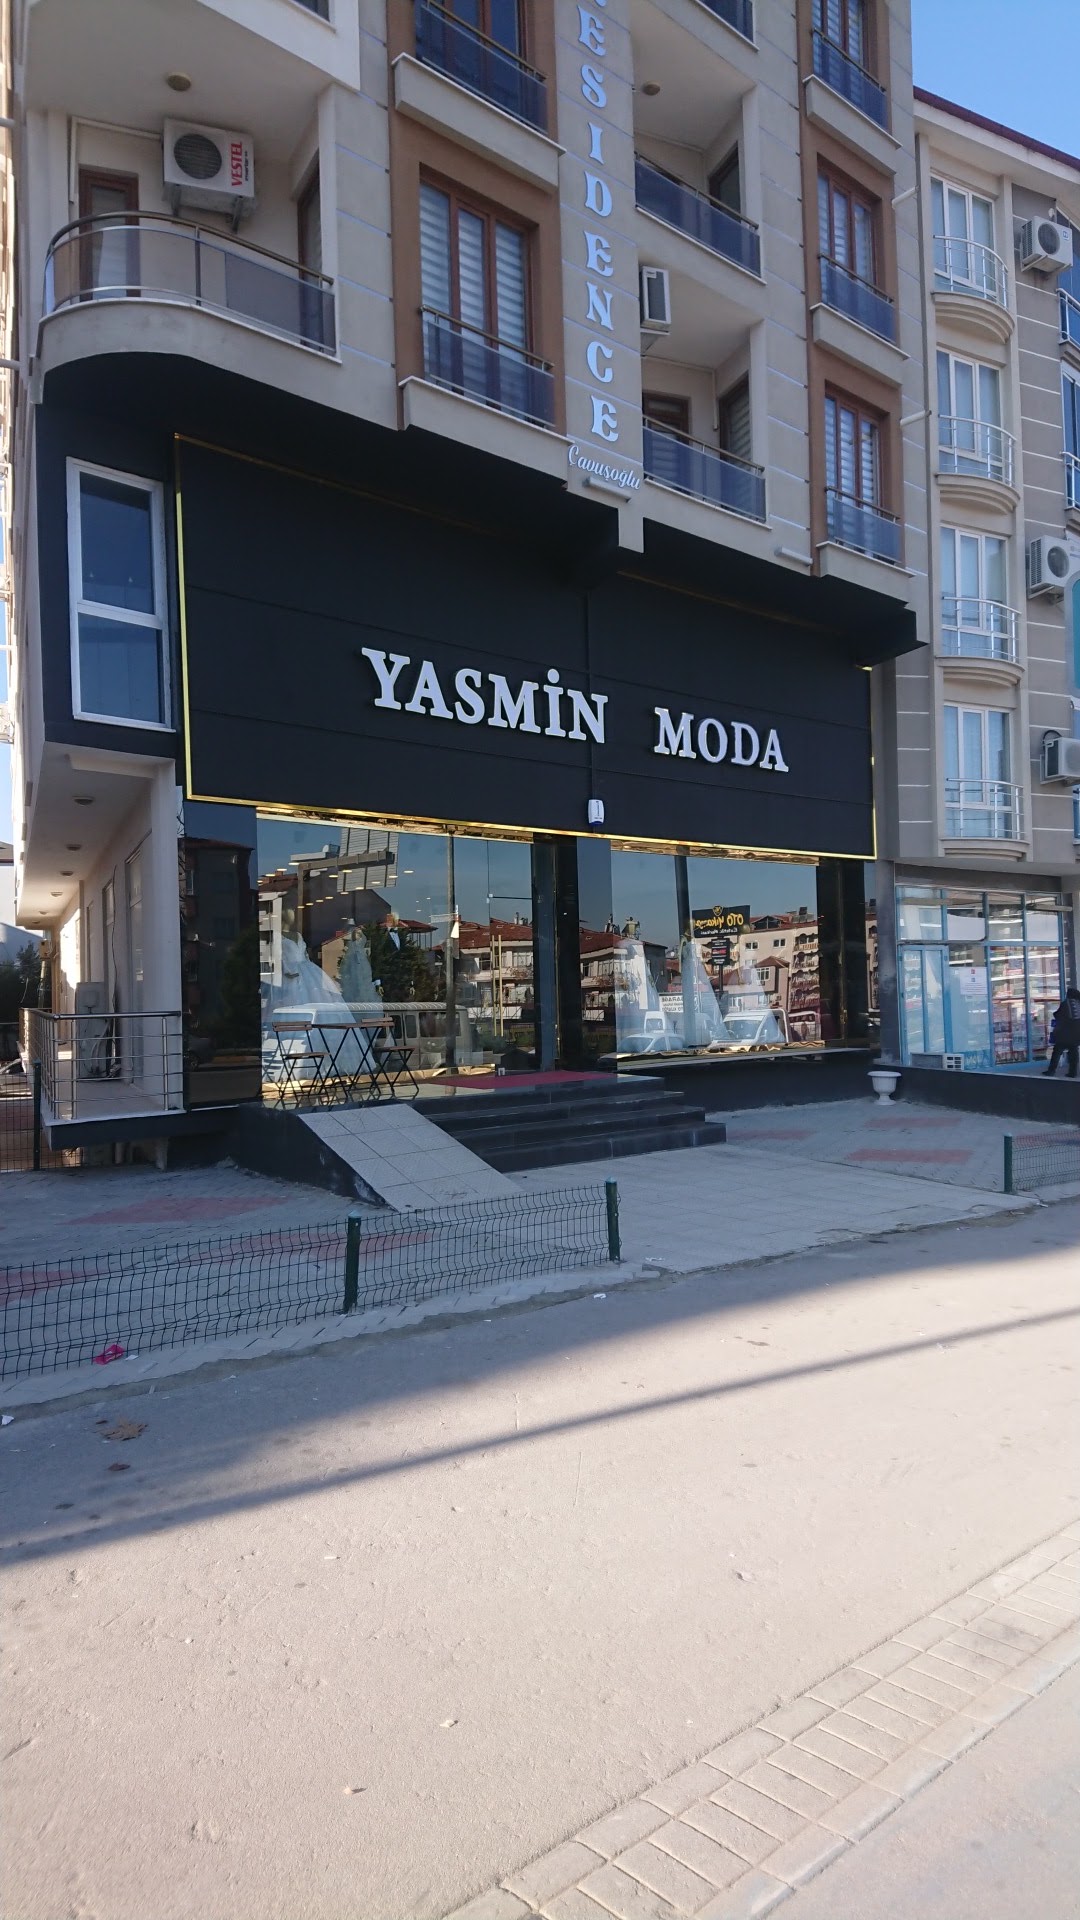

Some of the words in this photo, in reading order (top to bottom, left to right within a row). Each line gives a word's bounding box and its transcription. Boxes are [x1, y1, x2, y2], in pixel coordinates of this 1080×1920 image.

[231, 141, 243, 187] VESTEL
[577, 0, 619, 442] ESIDENCE
[568, 444, 640, 490] Çavuşoğlu
[361, 647, 608, 744] YASMİN
[654, 707, 789, 773] MODA
